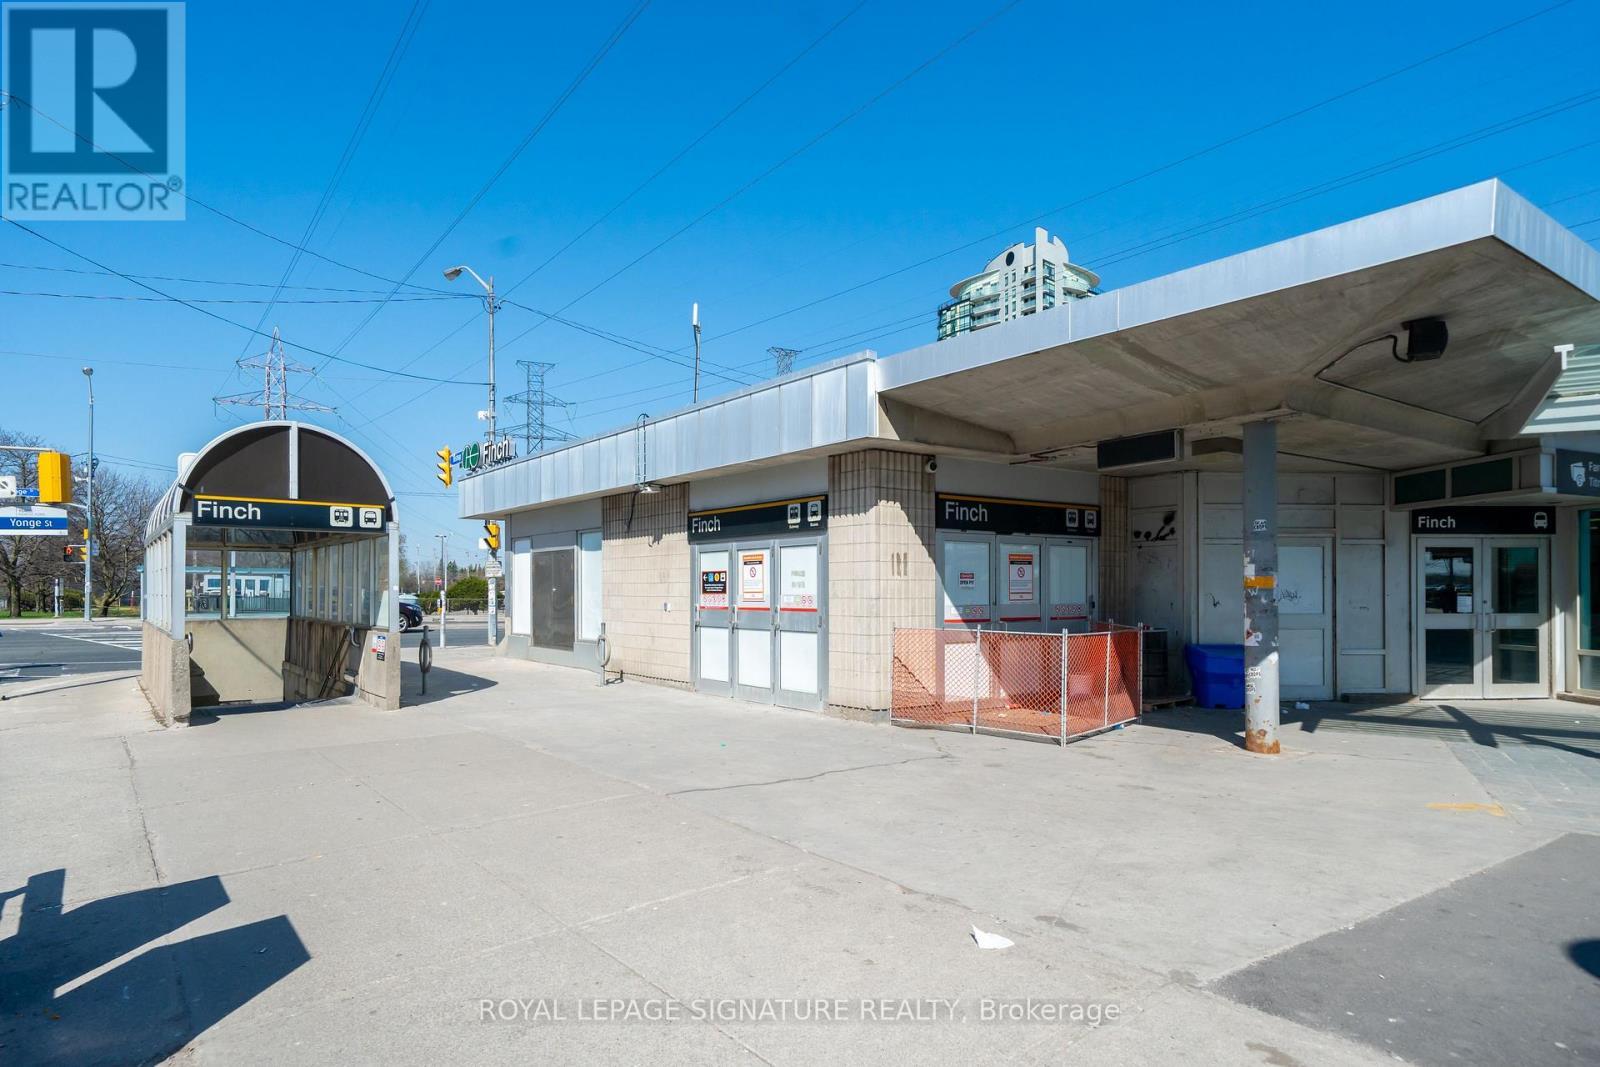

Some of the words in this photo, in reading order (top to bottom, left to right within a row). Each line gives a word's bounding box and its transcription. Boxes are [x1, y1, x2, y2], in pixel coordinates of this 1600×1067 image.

[482, 436, 509, 465] Finch
[197, 500, 261, 521] Finch
[944, 501, 989, 522] Finch
[9, 518, 42, 529] Yonge
[44, 519, 53, 527] St
[692, 515, 721, 533] Finch
[1417, 516, 1456, 529] Finch
